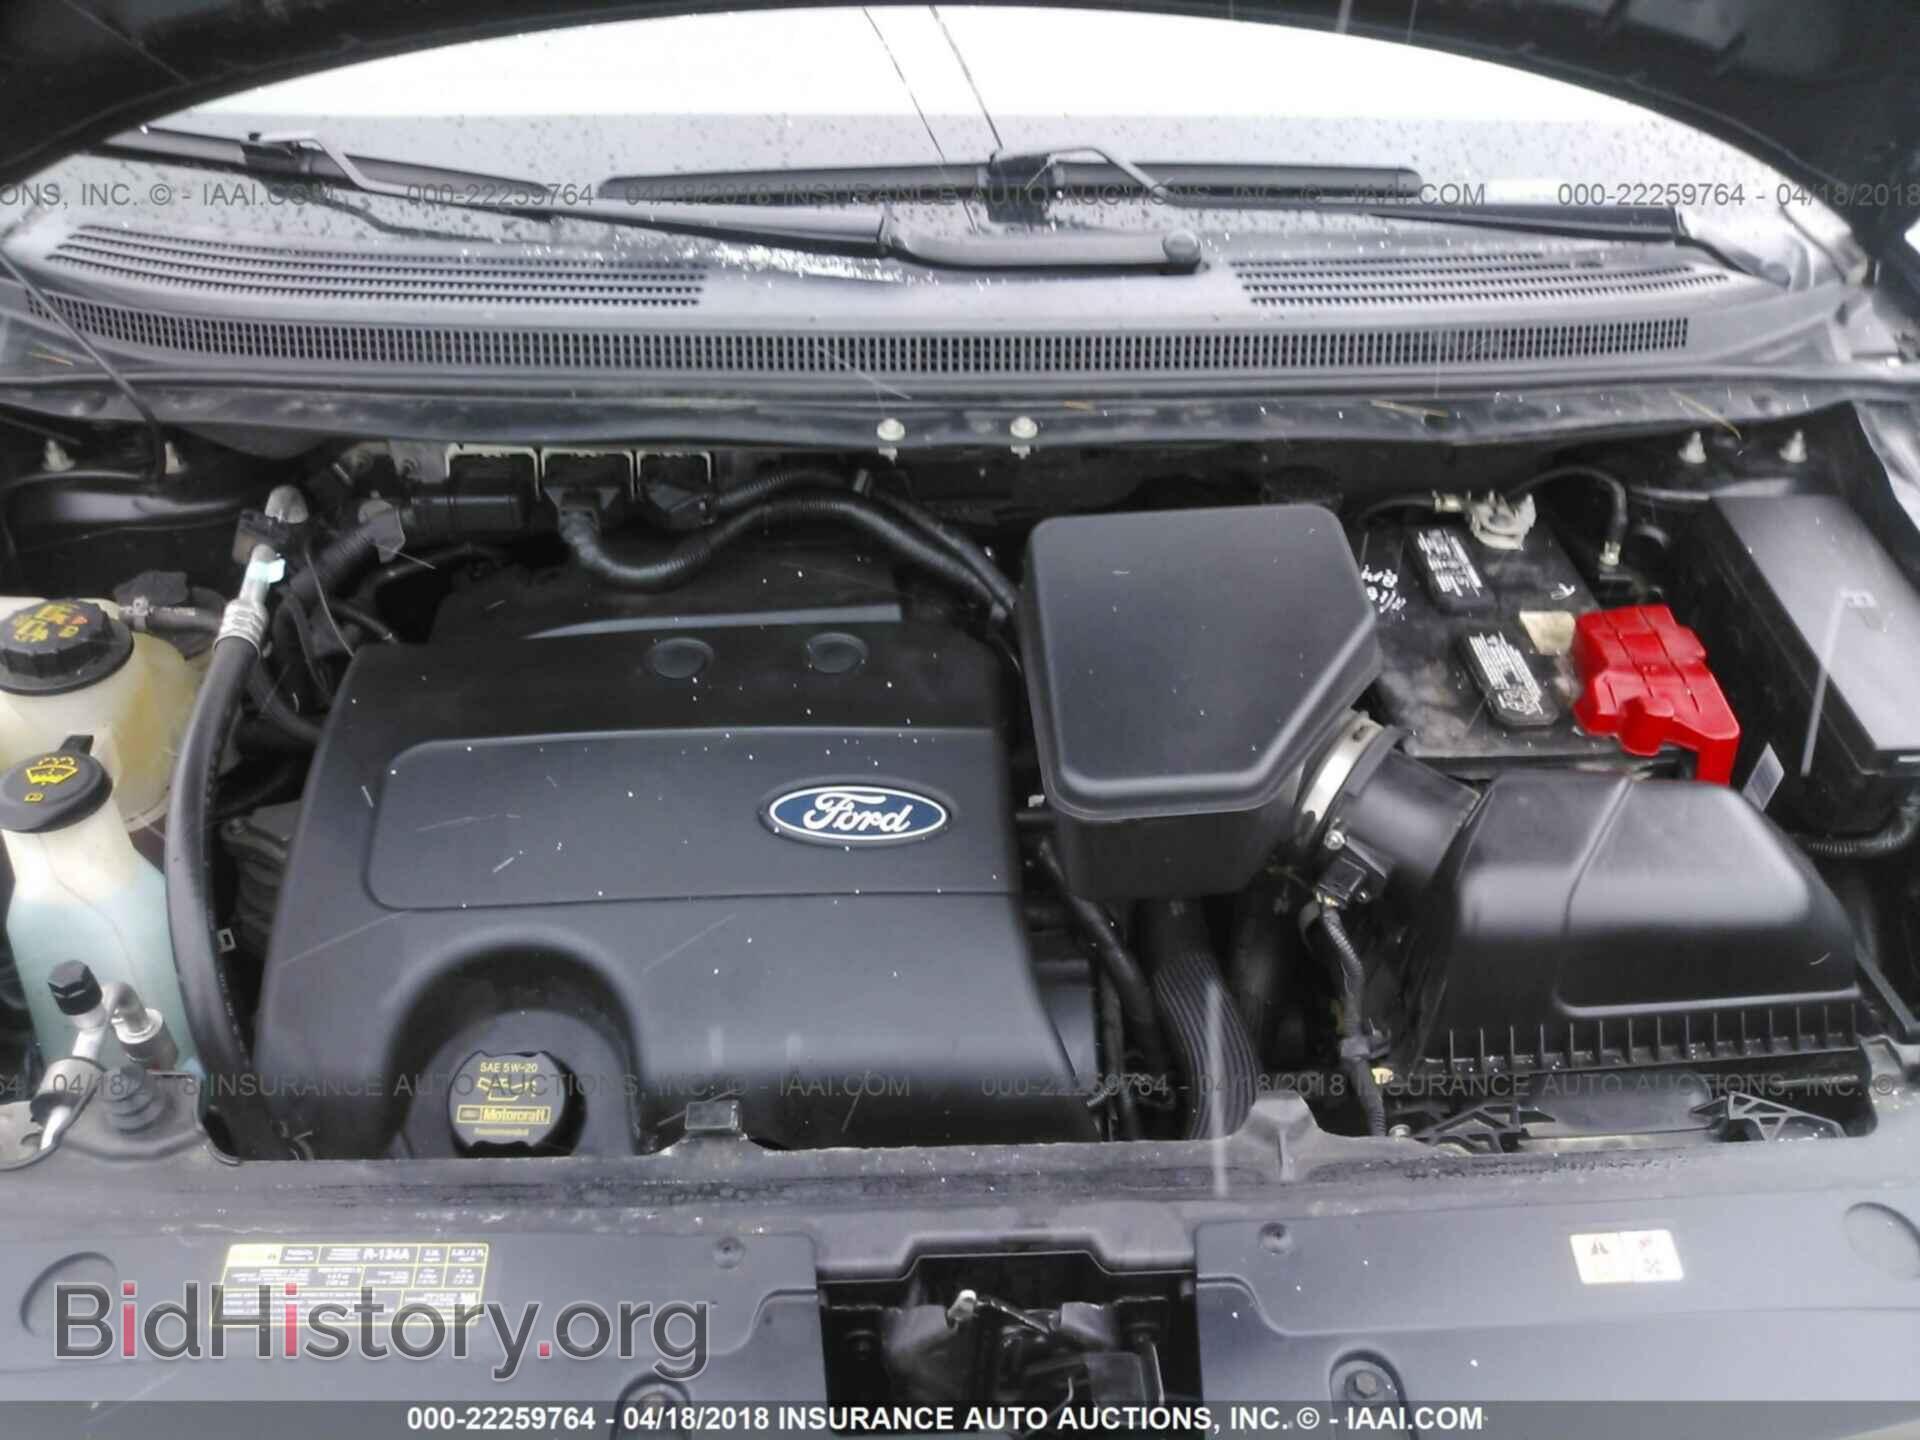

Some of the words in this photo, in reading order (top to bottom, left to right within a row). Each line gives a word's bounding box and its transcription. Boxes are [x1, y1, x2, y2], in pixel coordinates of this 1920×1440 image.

[802, 792, 914, 832] Ford
[480, 1062, 500, 1073] SAE
[502, 1062, 538, 1073] 5W-20
[362, 1248, 411, 1261] R-134A
